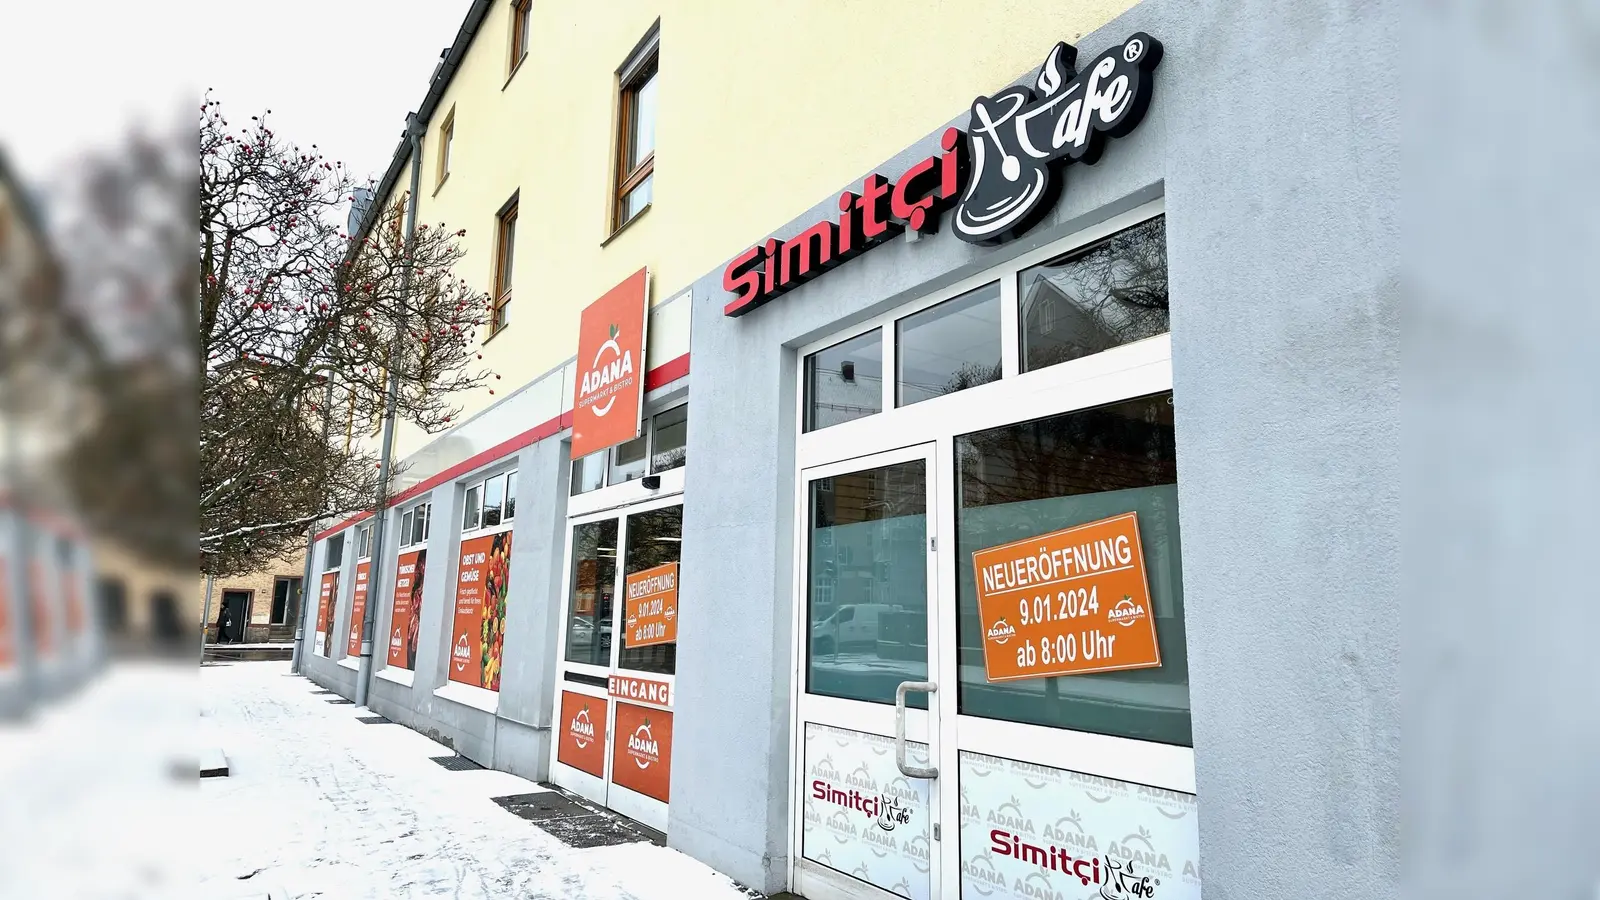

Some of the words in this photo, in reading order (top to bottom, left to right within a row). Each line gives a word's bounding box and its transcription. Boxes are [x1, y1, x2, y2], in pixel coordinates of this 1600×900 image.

[722, 127, 958, 316] Simitçi
[580, 350, 632, 398] ADANA
[578, 388, 609, 408] SUPERMARKT
[614, 377, 632, 393] BISTRO
[462, 554, 475, 566] OBST
[475, 552, 485, 564] UND
[982, 535, 1132, 592] NEUERÖFFNUNG
[461, 568, 479, 582] GEMÜSE
[628, 572, 674, 598] NEUERÖFFNUNG
[638, 598, 663, 618] 9.01.2024
[1019, 586, 1099, 626] 9.01.2024
[1108, 604, 1145, 619] ADANA
[635, 626, 642, 641] ab
[643, 623, 655, 640] 8:00
[656, 622, 667, 637] Uhr
[988, 625, 1016, 637] ADANA
[454, 644, 470, 658] ADANA
[1017, 640, 1036, 667] ab
[1041, 634, 1076, 664] 8:00
[1082, 630, 1116, 660] Uhr
[609, 678, 668, 702] EINGANG
[570, 718, 594, 736] ADANA
[628, 734, 658, 756] ADANA
[812, 780, 878, 818] Simitçi
[845, 774, 878, 792] ADANA
[883, 783, 920, 803] ADANA
[826, 816, 857, 836] ADANA
[862, 828, 897, 849] ADANA
[987, 810, 1035, 834] ADANA
[1043, 824, 1098, 852] ADANA
[1108, 841, 1171, 872] ADANA
[990, 830, 1100, 886] Simitçi
[962, 860, 1006, 888] ADANA
